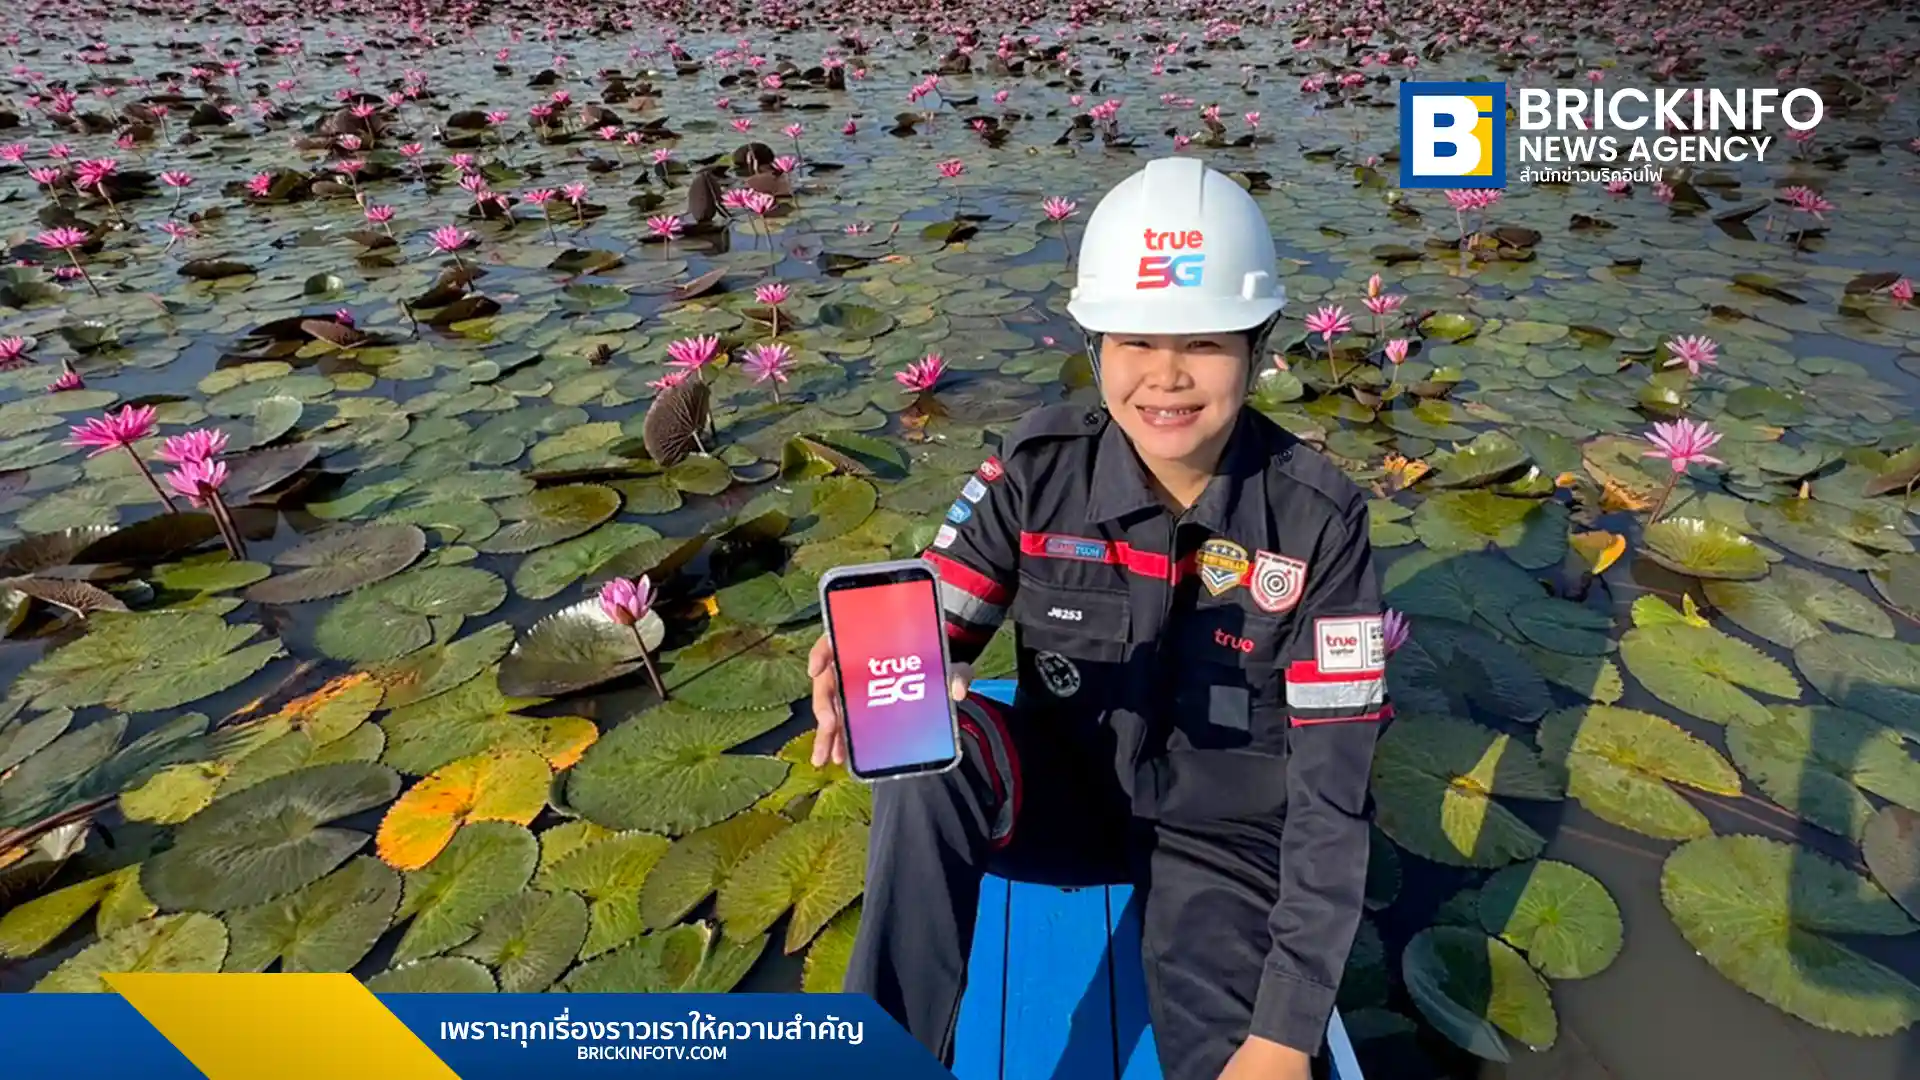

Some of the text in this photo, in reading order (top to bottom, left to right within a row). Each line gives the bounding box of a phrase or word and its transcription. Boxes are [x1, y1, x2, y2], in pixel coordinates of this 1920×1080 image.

[1143, 228, 1204, 250] true
[1135, 253, 1206, 290] 5G
[1214, 628, 1256, 653] true
[1325, 633, 1358, 648] true
[867, 654, 923, 676] true
[866, 673, 926, 708] 5G
